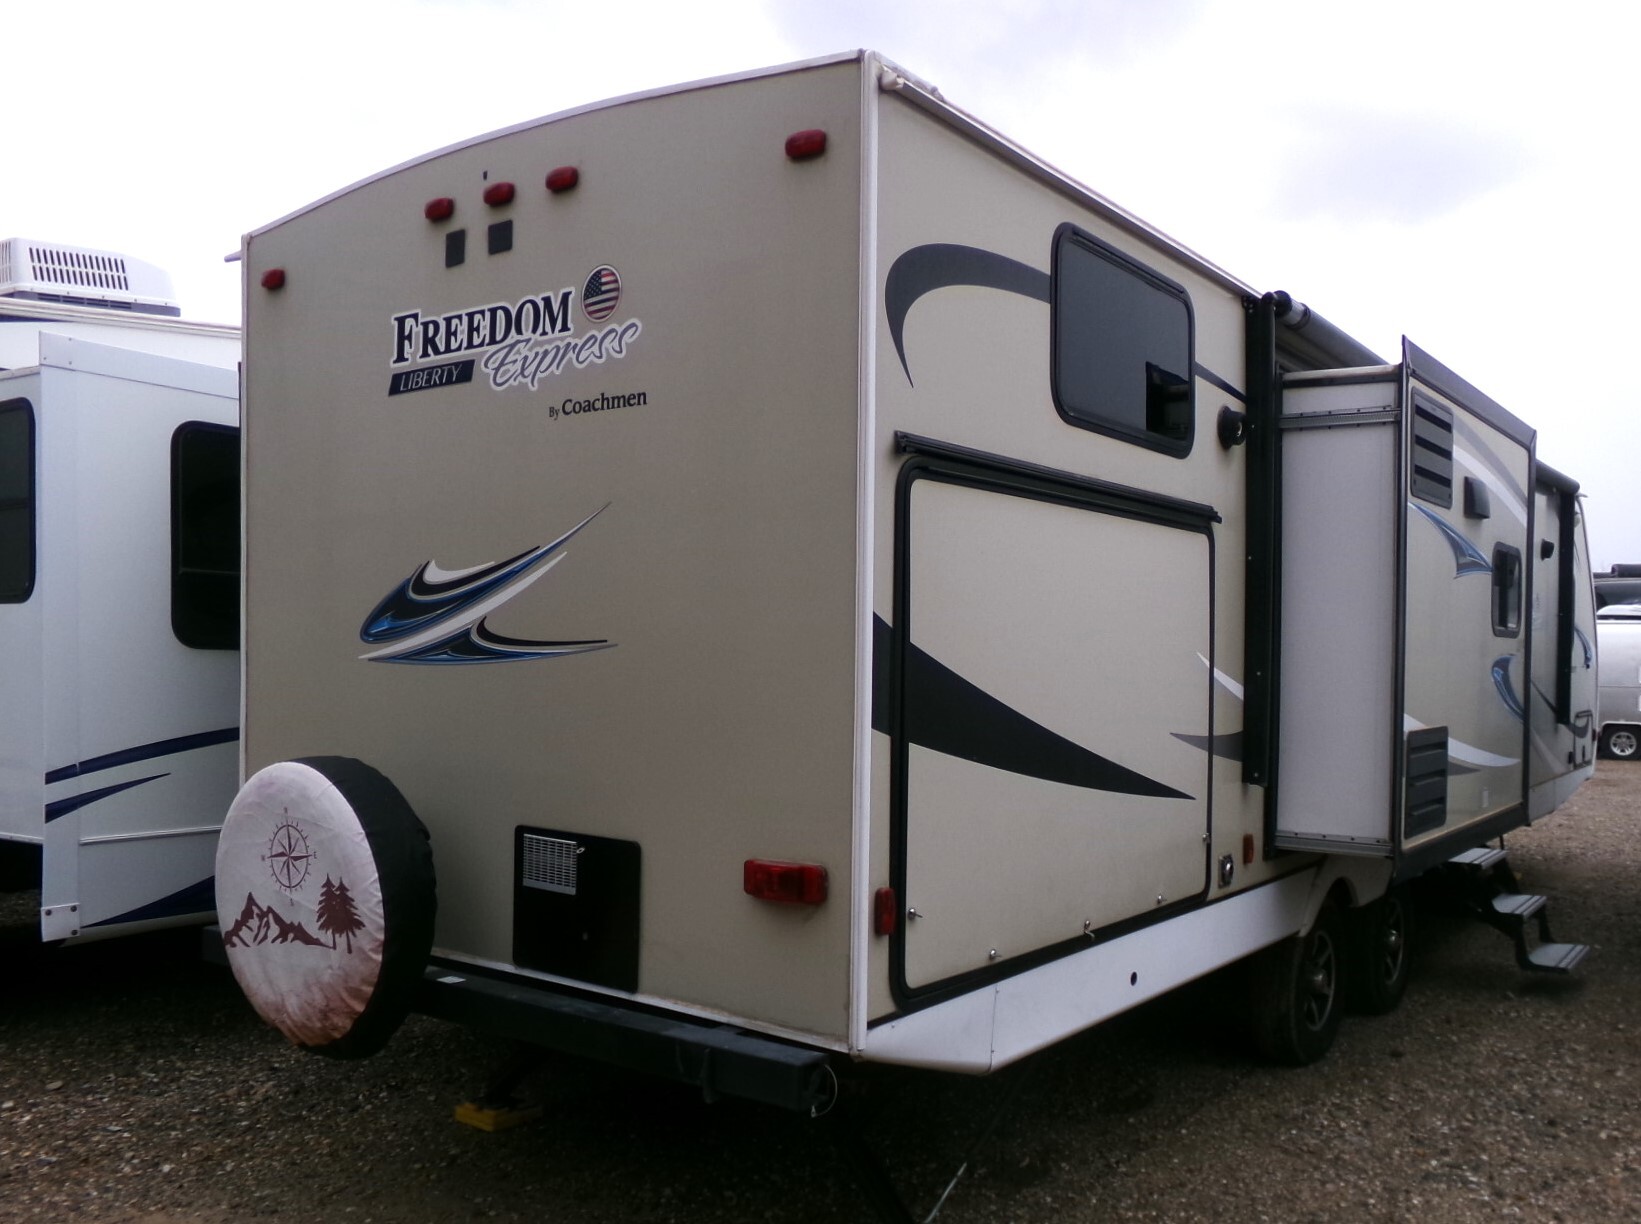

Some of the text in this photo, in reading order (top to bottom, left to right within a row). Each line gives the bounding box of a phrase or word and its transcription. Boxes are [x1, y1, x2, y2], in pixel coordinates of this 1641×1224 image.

[392, 289, 574, 365] FREEDOM
[399, 364, 462, 392] LIBERTY
[483, 321, 640, 388] Express
[548, 391, 648, 421] By Coachmen
